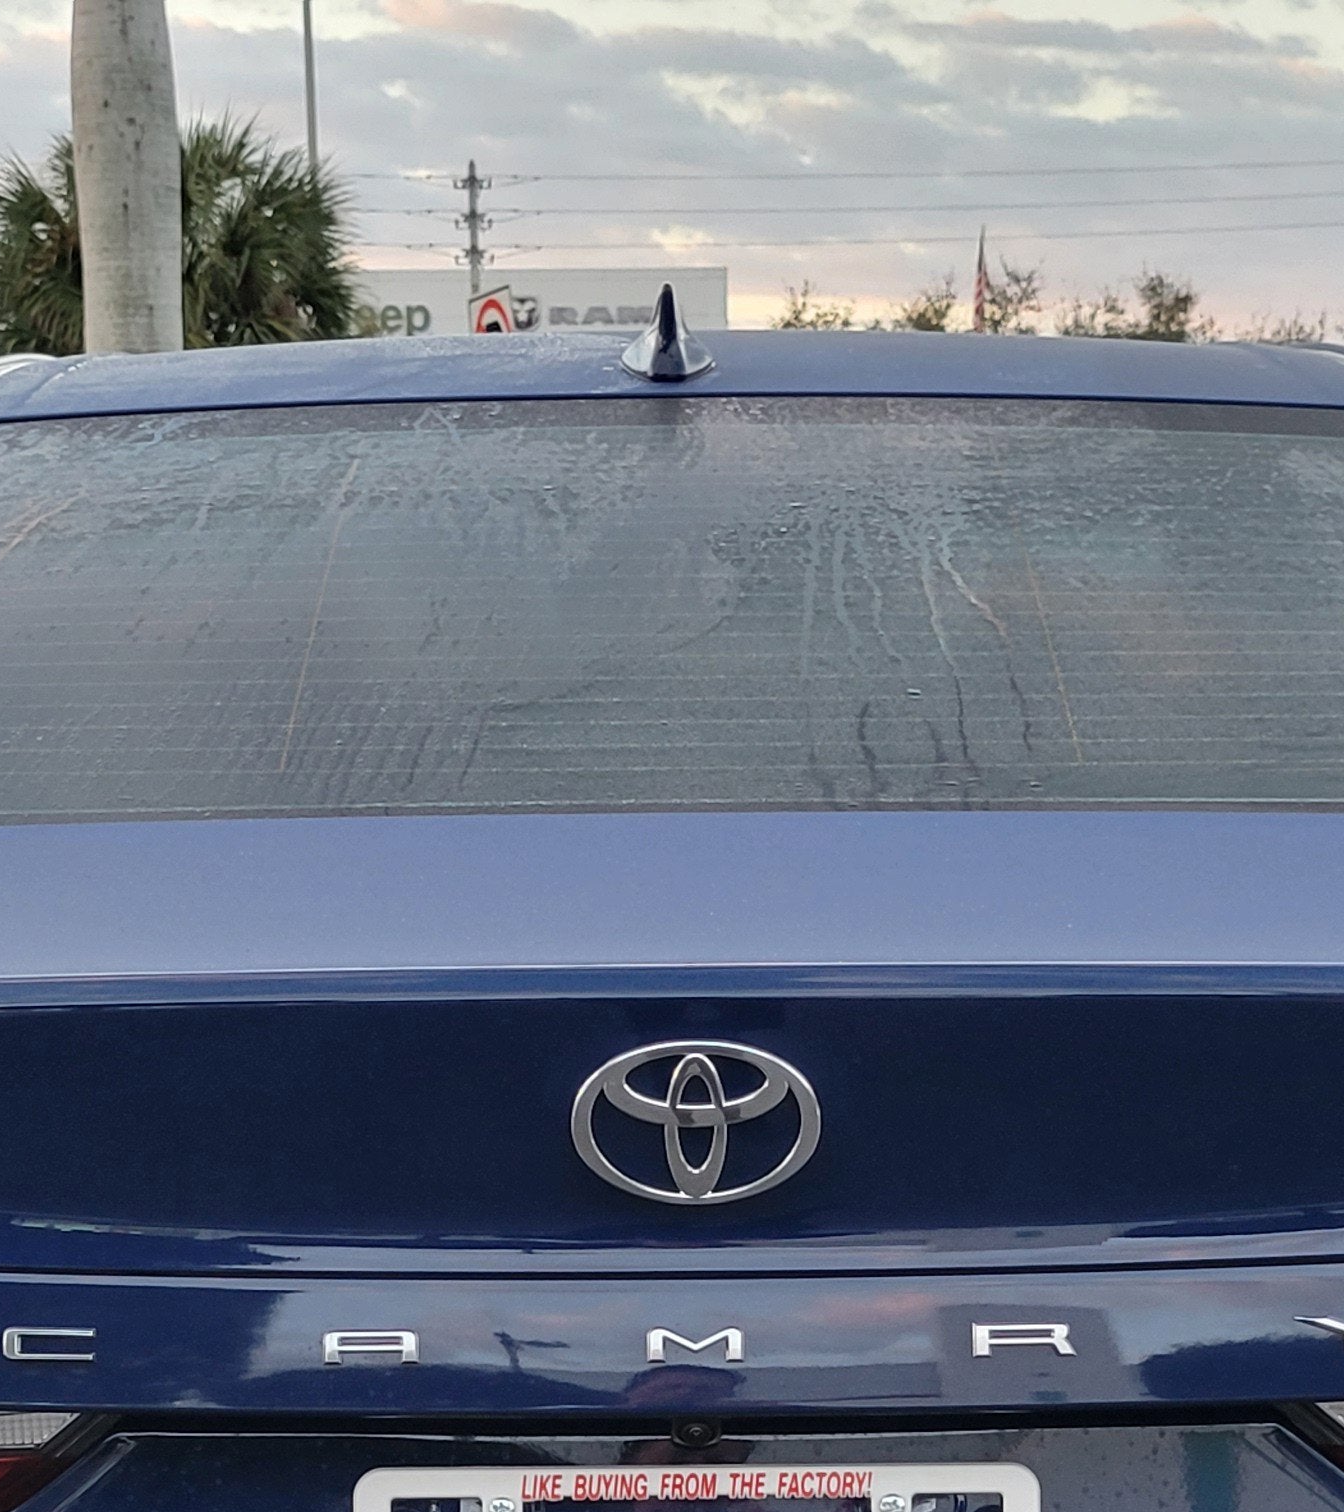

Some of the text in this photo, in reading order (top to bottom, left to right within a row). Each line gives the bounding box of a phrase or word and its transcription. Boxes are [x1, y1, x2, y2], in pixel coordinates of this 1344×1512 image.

[354, 304, 431, 336] eep
[549, 306, 654, 325] RAM
[521, 1471, 873, 1500] LIKE BUYING FROM THE FACTORY!
